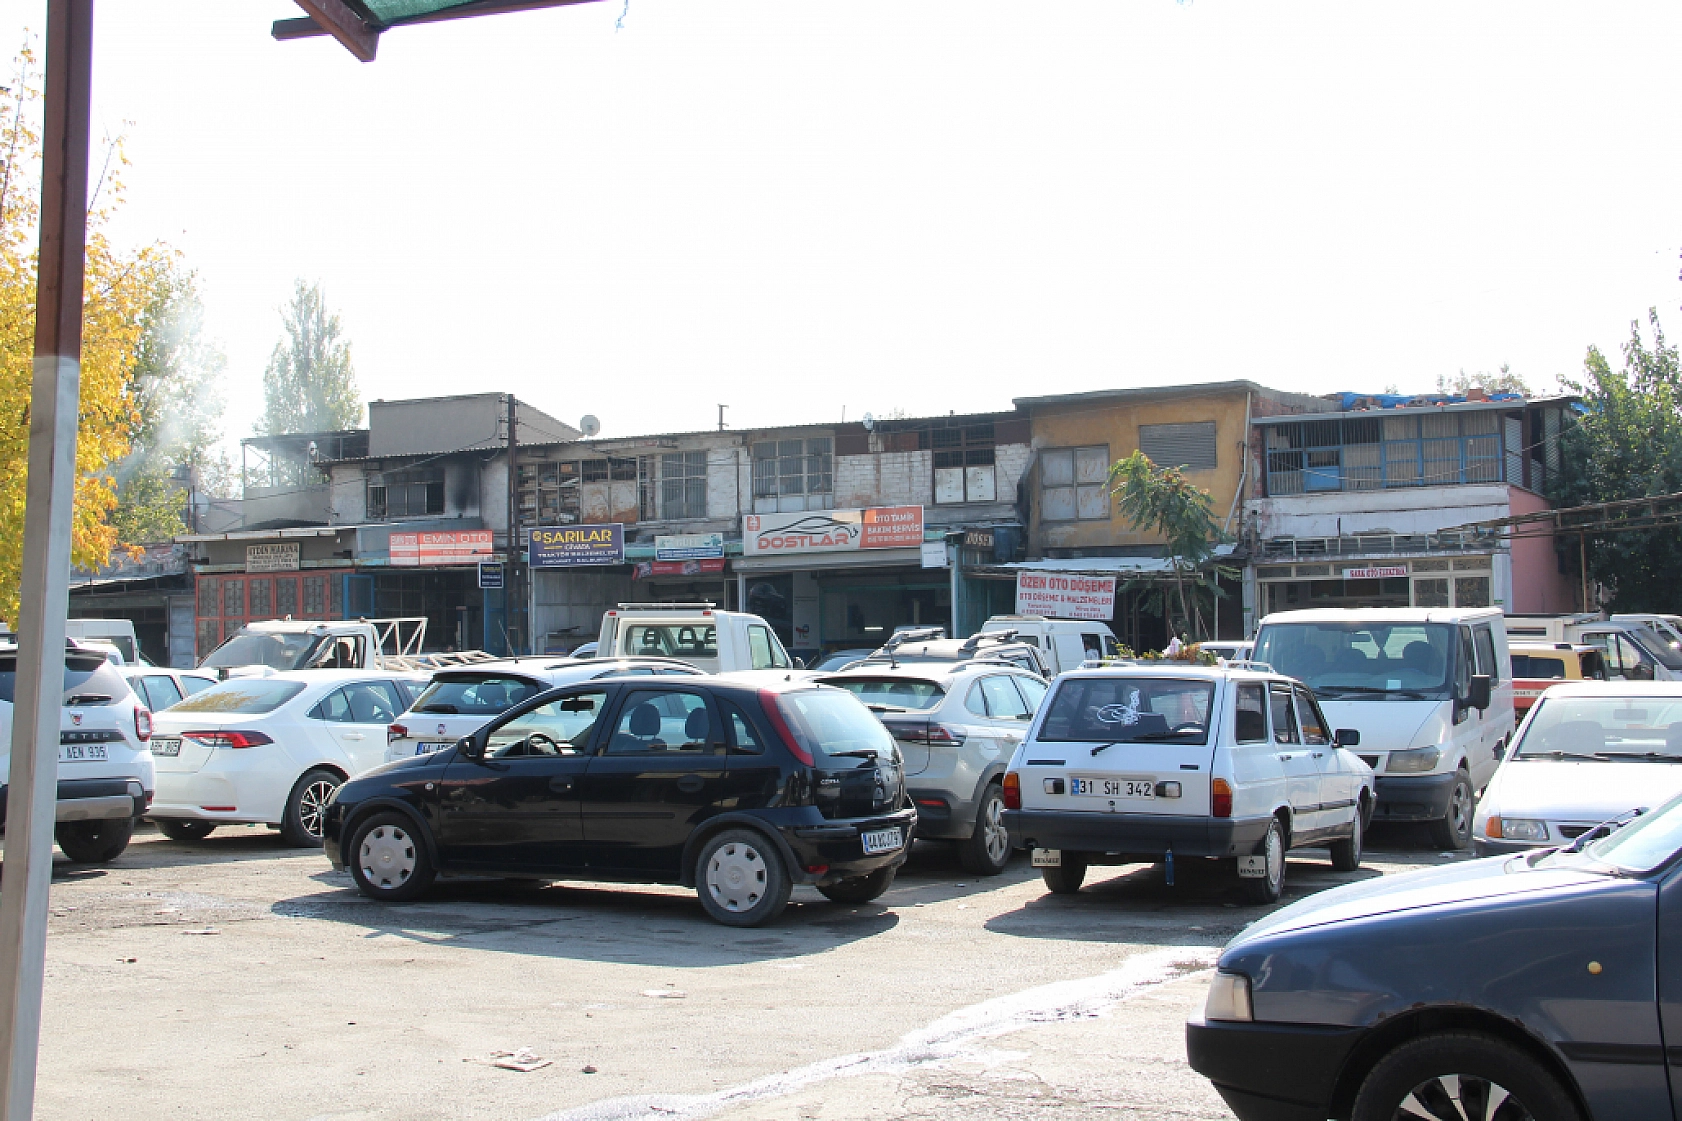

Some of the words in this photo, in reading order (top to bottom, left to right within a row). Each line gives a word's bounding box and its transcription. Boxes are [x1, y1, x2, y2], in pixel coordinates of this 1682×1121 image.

[875, 514, 890, 523] OTO
[891, 511, 915, 522] TAMİR
[460, 532, 488, 542] OTO
[543, 529, 612, 544] SARILAR
[758, 533, 849, 550] DOSTLAR
[1020, 573, 1046, 588] ÖZEN
[1049, 578, 1068, 590] OTO
[1070, 577, 1113, 593] DÖŞEME
[1020, 592, 1032, 600] OTO
[1033, 592, 1060, 602] DÖŞEME
[1067, 594, 1112, 605] MALZEMELERİ
[88, 746, 106, 758] 935
[1080, 780, 1093, 794] 31
[1104, 781, 1119, 795] SH
[1126, 782, 1152, 797] 342
